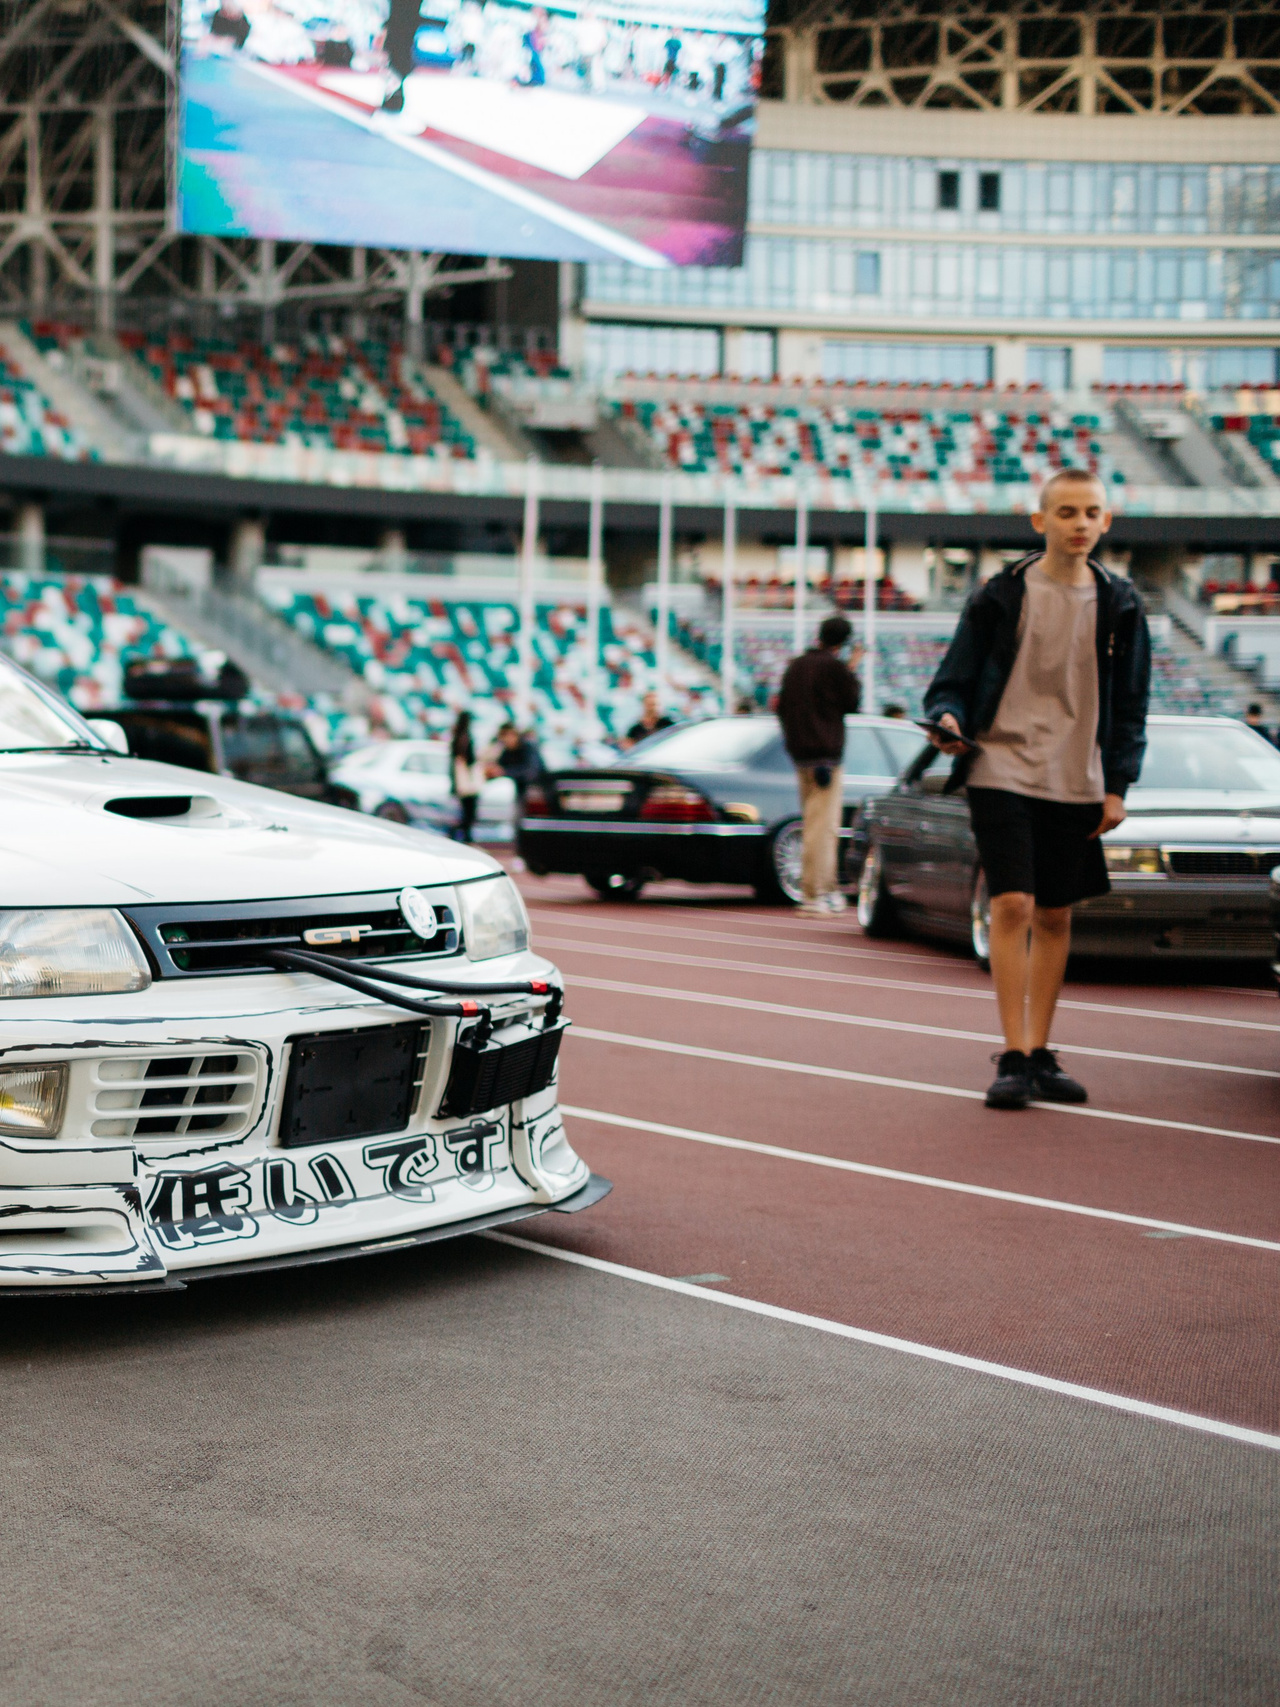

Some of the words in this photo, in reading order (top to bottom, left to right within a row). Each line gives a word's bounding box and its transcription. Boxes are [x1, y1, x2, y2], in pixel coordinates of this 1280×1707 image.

[303, 924, 373, 945] GT
[147, 1119, 504, 1250] 低いです
